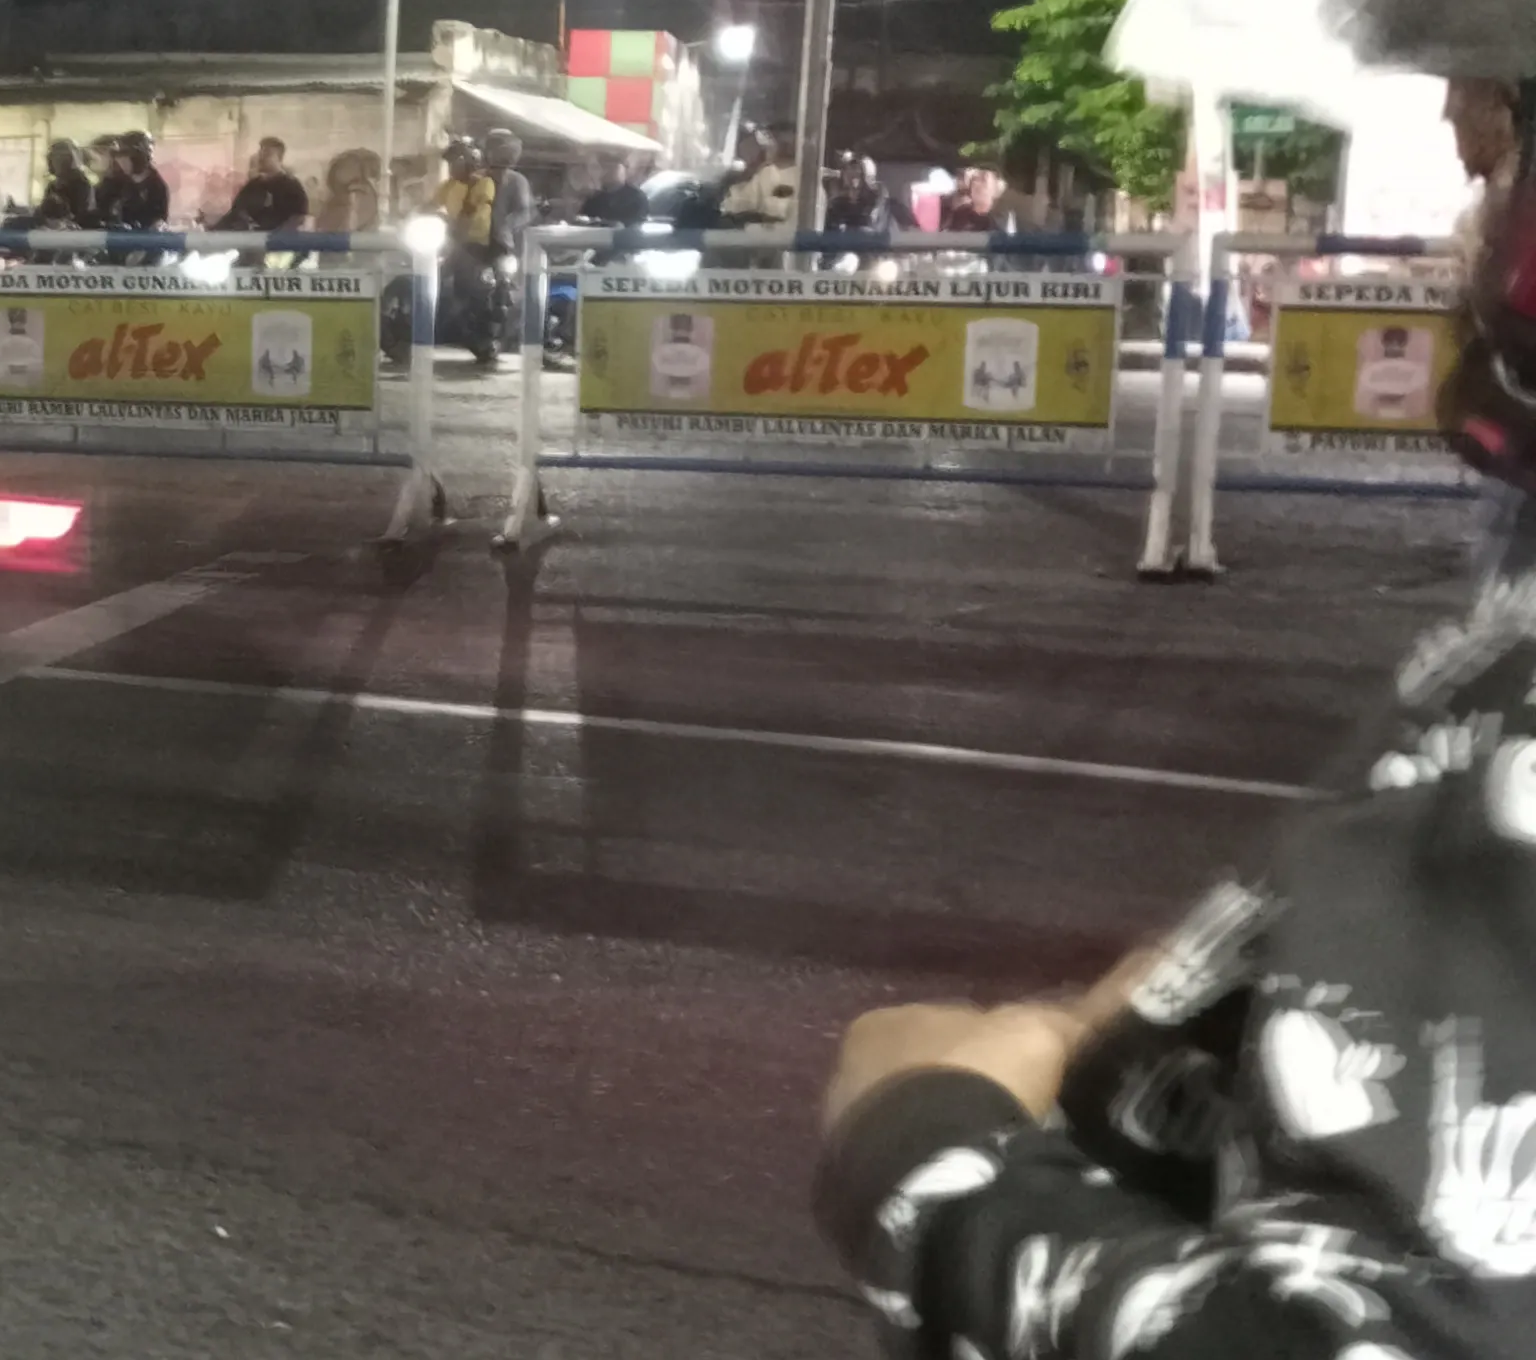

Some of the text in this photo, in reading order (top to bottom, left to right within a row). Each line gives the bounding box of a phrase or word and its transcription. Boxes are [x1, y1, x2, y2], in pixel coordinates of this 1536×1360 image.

[36, 274, 114, 290] MOTOR
[122, 275, 228, 291] GUNAK
[236, 276, 303, 297] LAJUR
[310, 277, 362, 293] KIRI
[602, 277, 1102, 300] SEPEDA MOTOR GUNAKAN LAJUR KIRI
[1298, 283, 1413, 303] SEPEDA
